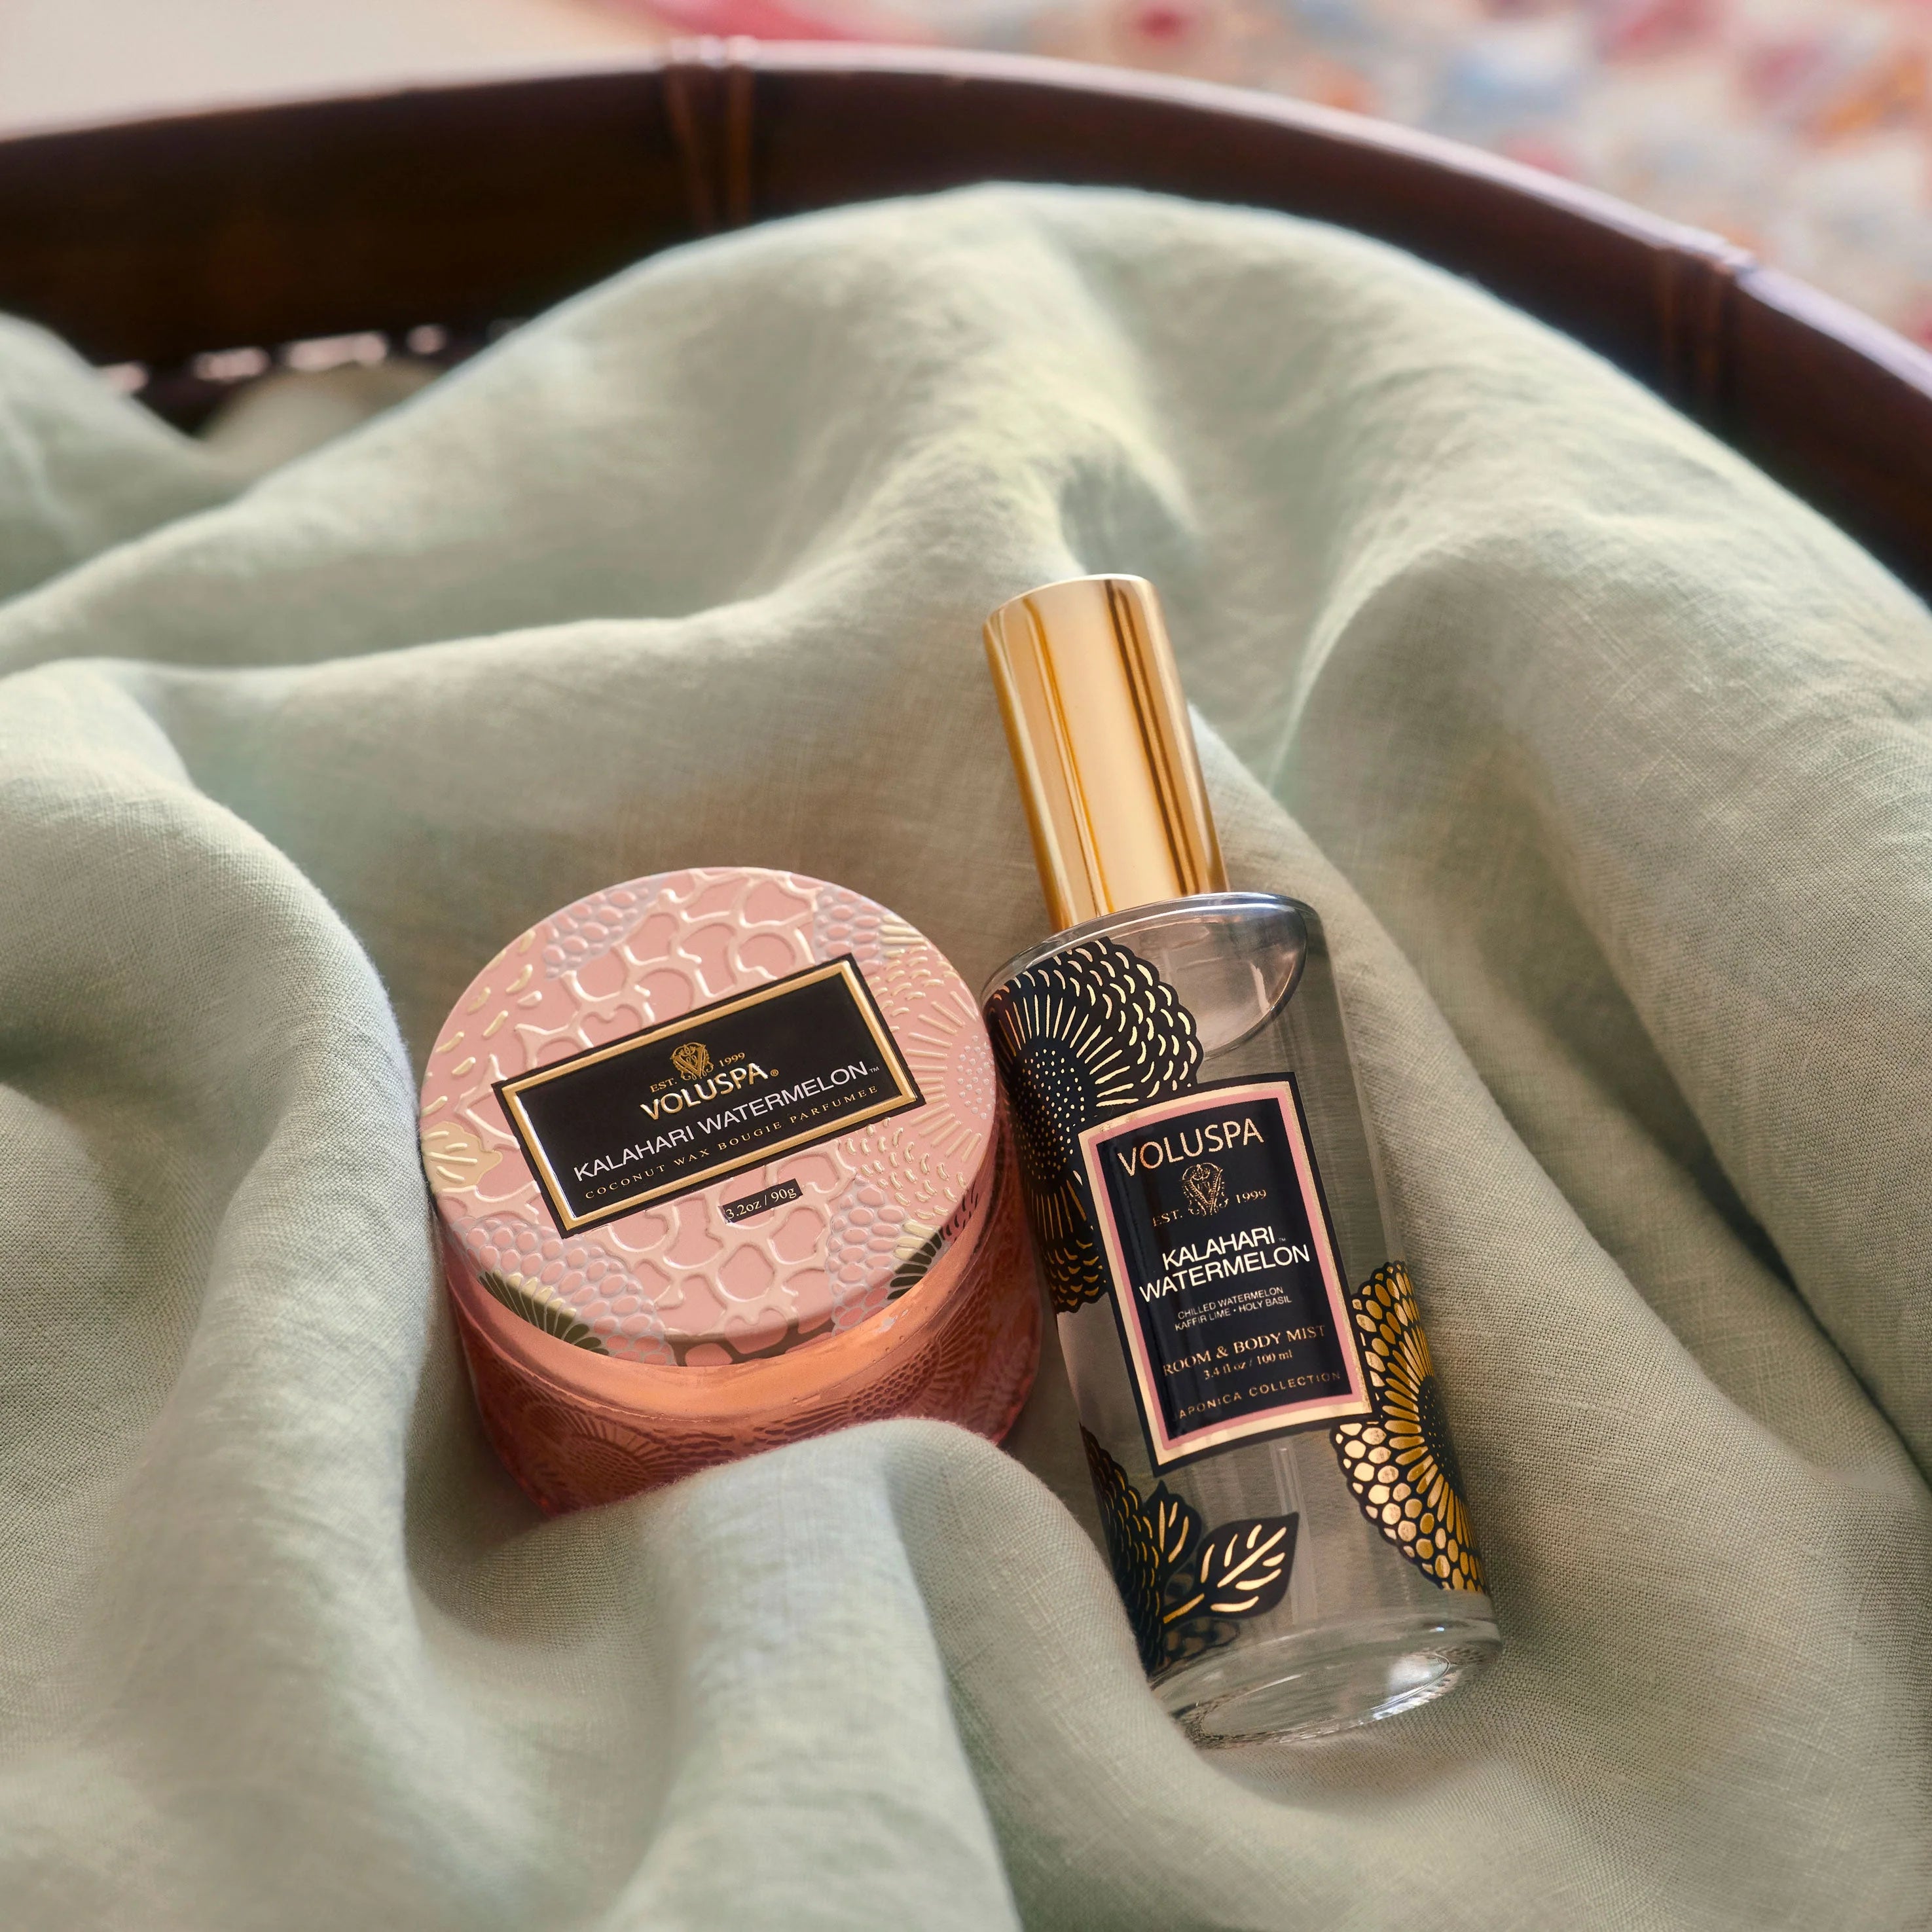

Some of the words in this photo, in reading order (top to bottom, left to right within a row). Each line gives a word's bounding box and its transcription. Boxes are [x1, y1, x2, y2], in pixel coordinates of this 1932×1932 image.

[649, 1078, 678, 1093] EST.
[719, 1052, 746, 1068] 1999
[574, 1125, 695, 1182] KALAHARI
[585, 1164, 665, 1199] COCONUT
[674, 1148, 710, 1166] WAX
[718, 1121, 782, 1151] BOUGIE
[790, 1085, 878, 1124] PARFUMEE
[1118, 1118, 1264, 1176] VOLUSPA
[725, 1200, 762, 1219] 3.2oz
[771, 1187, 797, 1203] 90g
[1152, 1209, 1183, 1226] EST.
[1236, 1189, 1267, 1204] 1999
[1139, 1245, 1310, 1302] WATERMELON
[1175, 1314, 1207, 1331] KAFFIR
[1209, 1309, 1231, 1321] LIME
[1239, 1302, 1264, 1313] HOLY
[1266, 1295, 1292, 1307] BASIL
[1178, 1302, 1216, 1320] CHILLED
[1218, 1286, 1284, 1307] WATERMELON
[1163, 1350, 1211, 1376] ROOM
[1216, 1346, 1229, 1358] &
[1233, 1332, 1281, 1354] BODY
[1286, 1325, 1326, 1343] MIST
[1203, 1366, 1220, 1380] 3.4
[1257, 1351, 1276, 1365] 100
[1279, 1349, 1293, 1360] ml
[1175, 1392, 1242, 1420] APONICA
[1249, 1372, 1341, 1397] COLLECTION
